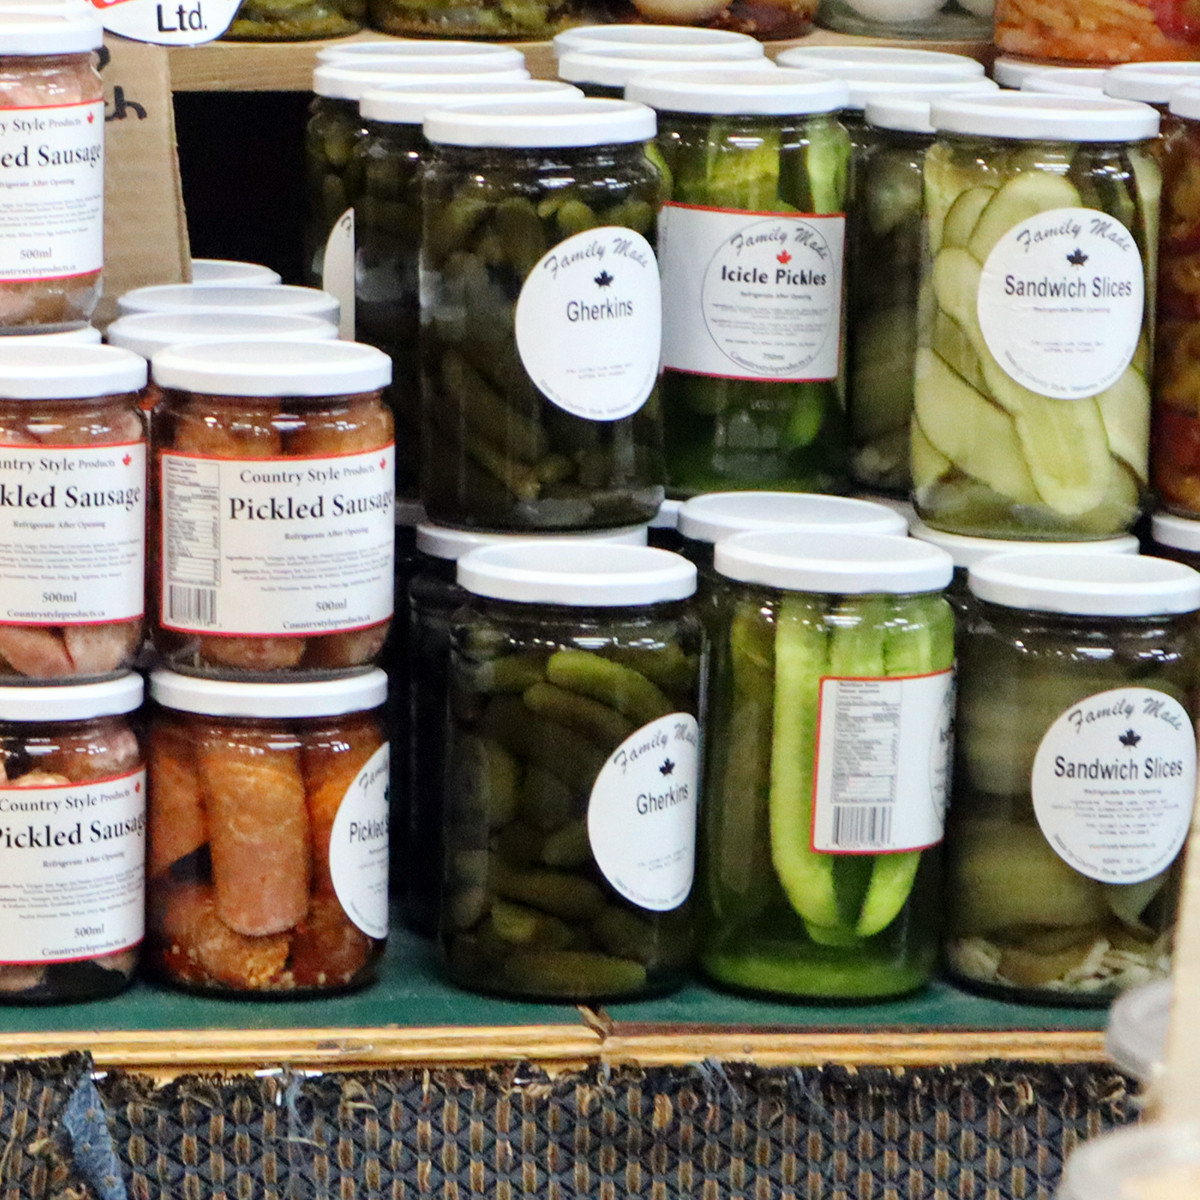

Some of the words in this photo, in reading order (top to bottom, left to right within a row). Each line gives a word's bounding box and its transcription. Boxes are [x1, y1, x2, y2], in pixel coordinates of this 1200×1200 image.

[156, 2, 208, 34] Ltd.
[12, 116, 46, 136] Style
[730, 226, 788, 256] Family
[794, 227, 828, 260] Made
[1016, 218, 1082, 253] Family
[1089, 218, 1132, 252] Made
[544, 240, 606, 280] Family
[613, 237, 649, 269] Made
[721, 265, 768, 284] Icicle
[775, 269, 827, 286] Pickles
[1004, 274, 1086, 299] Sandwich
[1092, 276, 1132, 299] Slices
[566, 297, 634, 323] Gherkins
[39, 456, 76, 475] Style
[240, 469, 304, 485] Country
[307, 466, 340, 486] Style
[64, 484, 141, 512] Sausage
[229, 496, 325, 521] Pickled
[42, 591, 77, 603] 500ml
[315, 598, 347, 612] 500ml
[1068, 698, 1135, 734] Family
[1143, 697, 1183, 731] Made
[613, 729, 669, 776] Family
[1054, 756, 1139, 780] Sandwich
[1144, 757, 1183, 780] Slices
[65, 793, 98, 812] Style
[636, 782, 689, 816] Gherkins
[90, 814, 146, 844] Sausag
